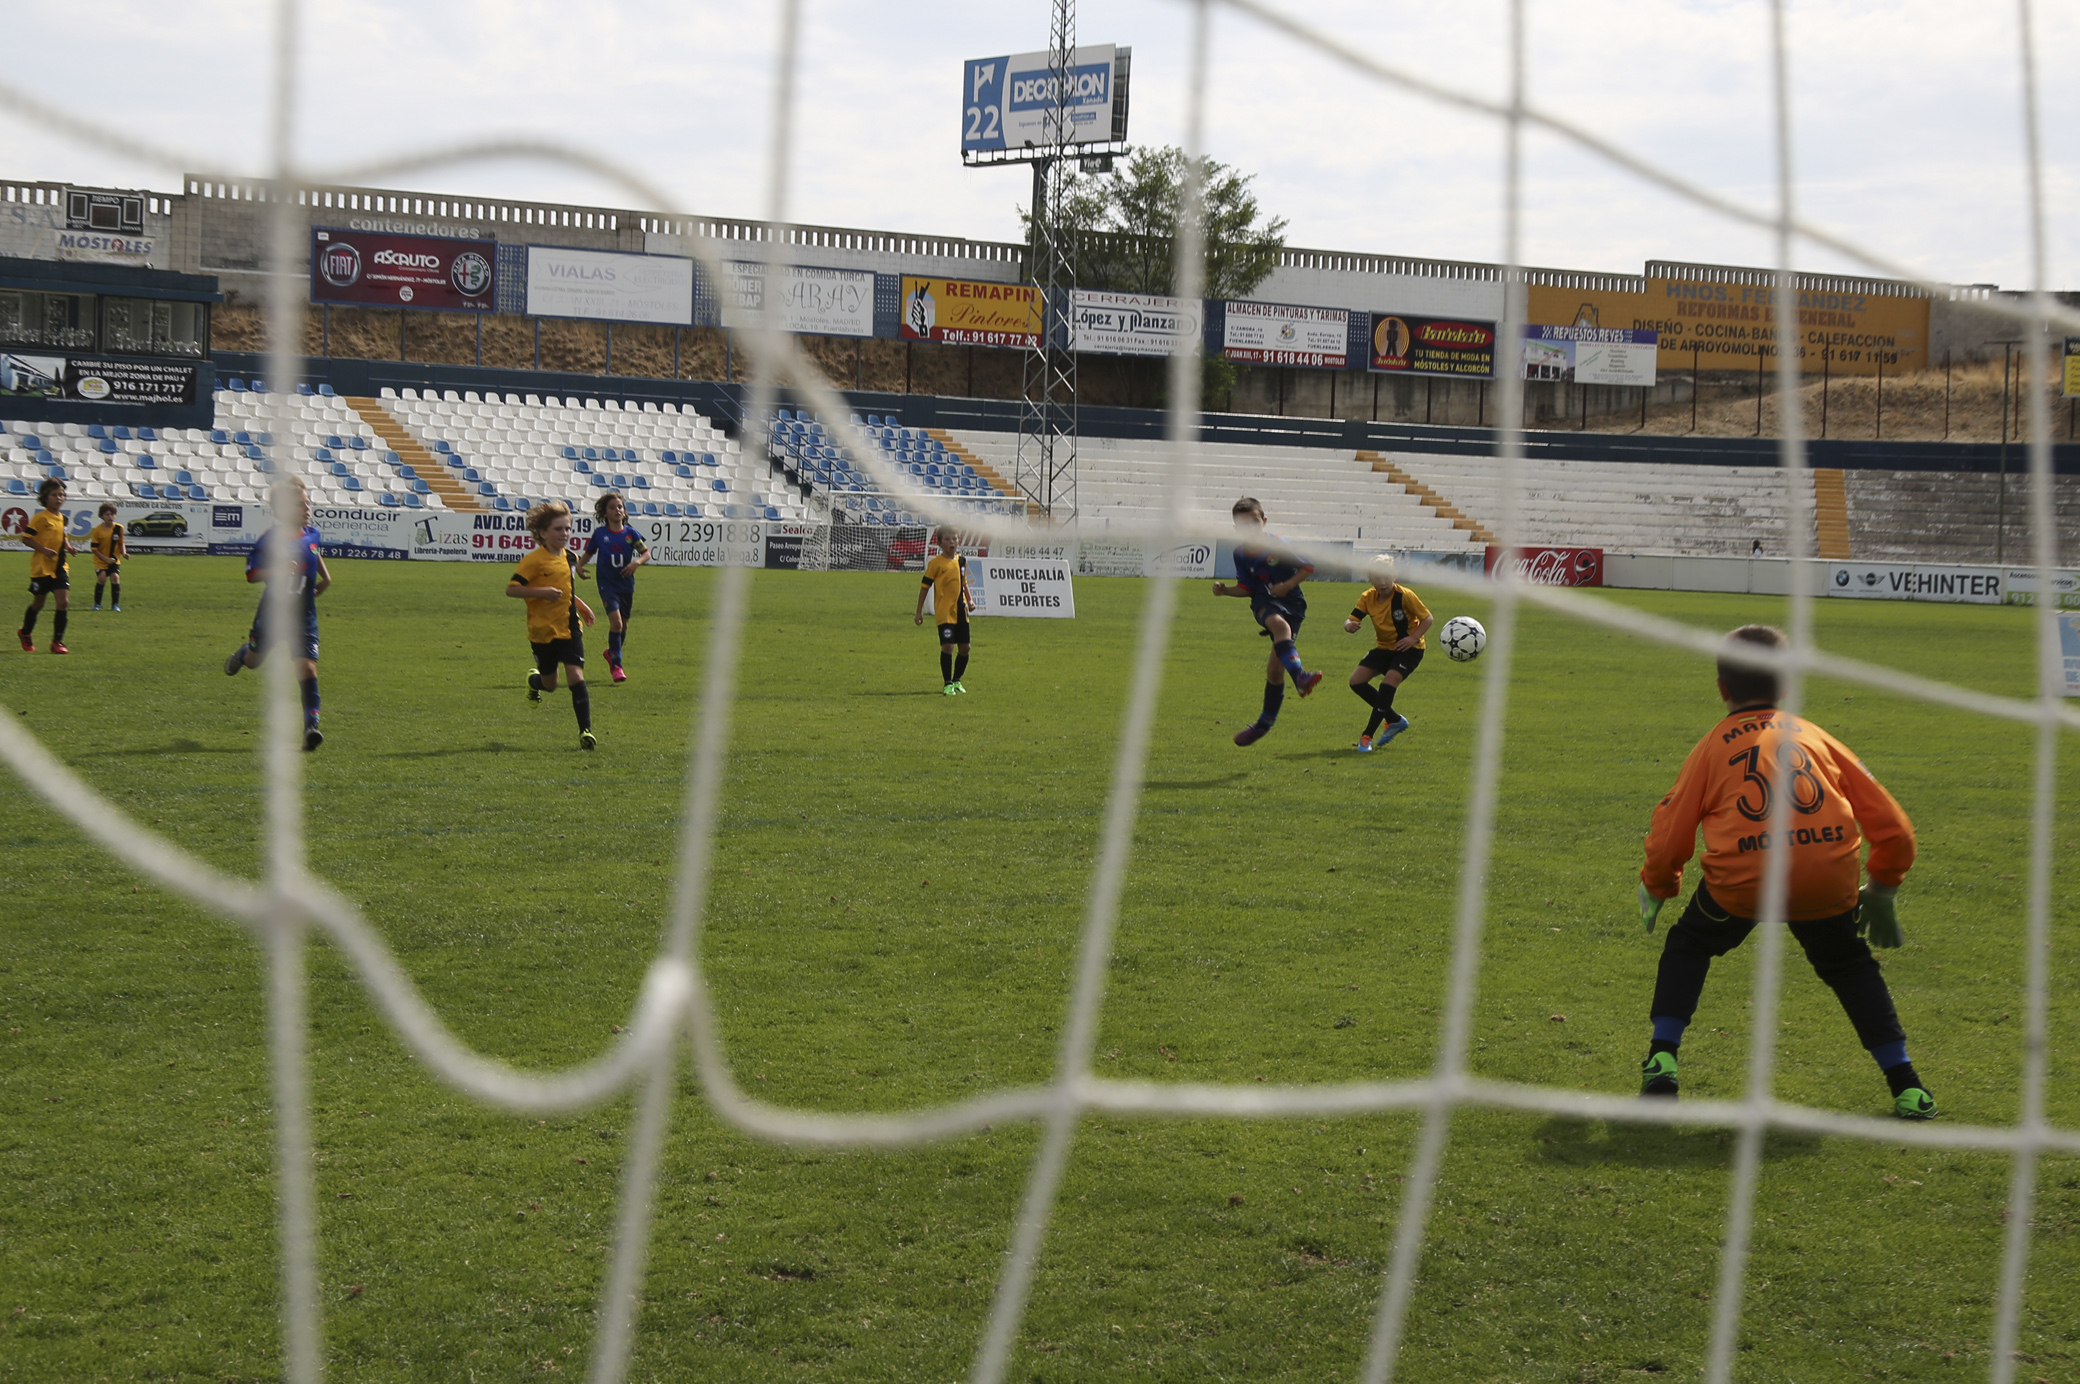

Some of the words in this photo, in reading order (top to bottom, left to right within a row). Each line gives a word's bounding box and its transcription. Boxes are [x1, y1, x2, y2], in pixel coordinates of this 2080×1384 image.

[1014, 72, 1104, 103] DECATHLON
[965, 105, 999, 141] 22
[350, 218, 480, 240] contenedores
[330, 255, 353, 276] FIAT
[374, 250, 440, 268] ASCAUTO
[453, 257, 467, 274] ALFA
[469, 254, 489, 277] ROMEO
[548, 263, 616, 281] VIALAS
[792, 268, 803, 279] EN
[805, 269, 837, 281] COMIDA
[839, 272, 866, 283] TURCA
[945, 282, 1035, 302] REMAPIN
[1666, 282, 1734, 302] HNOS.
[1742, 288, 1867, 312] FERANDEZ
[949, 302, 1032, 328] Pintores
[1227, 303, 1261, 316] ALMACEN
[1262, 306, 1271, 317] DE
[1273, 306, 1308, 320] PINTURAS
[1309, 309, 1315, 320] Y
[1316, 310, 1347, 322] TARIMAS
[1677, 301, 1760, 321] REFORMAS
[1118, 315, 1126, 332] y
[972, 332, 984, 343] 91
[987, 332, 1006, 344] 617
[1009, 334, 1021, 345] 77
[1552, 326, 1598, 341] REPUESTOS
[1599, 329, 1624, 342] REYES
[1633, 318, 1684, 335] DISEÑO
[1808, 331, 1895, 348] CALEFACCION
[1230, 350, 1243, 359] JUAN
[1263, 351, 1274, 363] 91
[1277, 352, 1295, 364] 618
[1297, 353, 1309, 365] 44
[1311, 354, 1323, 366] 06
[1415, 349, 1424, 358] TU
[1425, 350, 1449, 359] TIENDA
[1450, 351, 1460, 360] DE
[1461, 352, 1480, 361] MODA
[1481, 354, 1491, 362] EN
[1660, 338, 1677, 350] DE
[1840, 350, 1860, 362] 617
[71, 360, 101, 368] CAMBIE
[102, 361, 114, 369] SU
[114, 362, 132, 370] PISO
[133, 363, 151, 372] POR
[151, 364, 163, 373] UN
[163, 364, 193, 374] CHALET
[1414, 360, 1449, 371] MÓSTOLES
[1450, 363, 1455, 371] Y
[1455, 362, 1490, 373] ALCORCÓN
[102, 370, 128, 379] MEJOR
[129, 371, 151, 380] ZONA
[152, 373, 163, 381] DE
[113, 381, 136, 391] 916
[139, 382, 159, 392] 171
[162, 383, 185, 393] 717
[160, 502, 183, 510] CACTUS
[313, 508, 400, 522] conducir
[310, 520, 389, 532] experiencia
[414, 515, 468, 545] Tizas
[651, 522, 671, 541] 91
[783, 524, 813, 535] Sealco
[472, 534, 494, 549] 91
[499, 535, 536, 550] 645
[331, 548, 343, 557] 91
[347, 549, 368, 558] 226
[370, 550, 384, 558] 78
[387, 550, 401, 559] 48
[651, 546, 662, 561] C/
[664, 546, 700, 562] Ricardo
[702, 547, 715, 562] de
[717, 547, 725, 562] la
[1005, 546, 1015, 555] 91
[1038, 546, 1050, 556] 44
[1052, 547, 1064, 556] 47
[990, 566, 1065, 581] CONCEJALÍA
[1021, 582, 1036, 594] DE
[1889, 572, 1999, 596] VEHINTER
[999, 595, 1060, 607] DEPORTES
[1722, 720, 1803, 744] MARIO
[1729, 742, 1824, 822] 38
[1738, 825, 1844, 853] MÓTOLES
